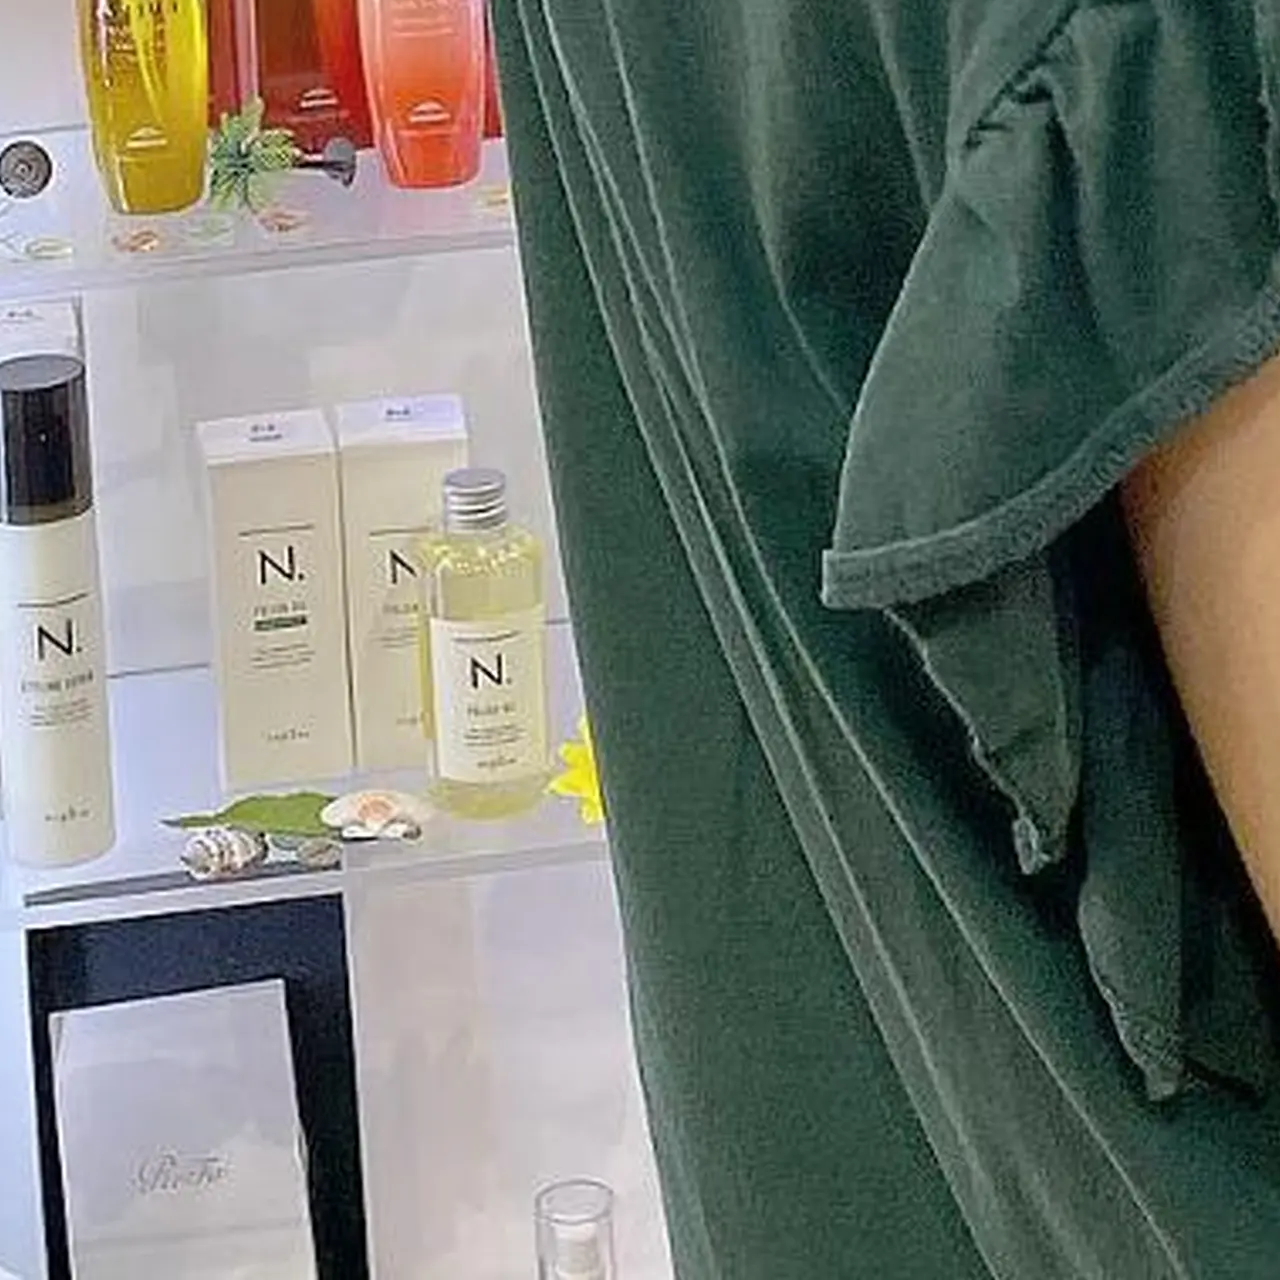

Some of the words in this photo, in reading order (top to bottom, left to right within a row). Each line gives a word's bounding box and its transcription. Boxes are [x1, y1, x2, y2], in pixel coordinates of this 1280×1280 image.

[258, 545, 305, 585] N.
[36, 617, 84, 661] N.
[470, 653, 513, 689] N.
